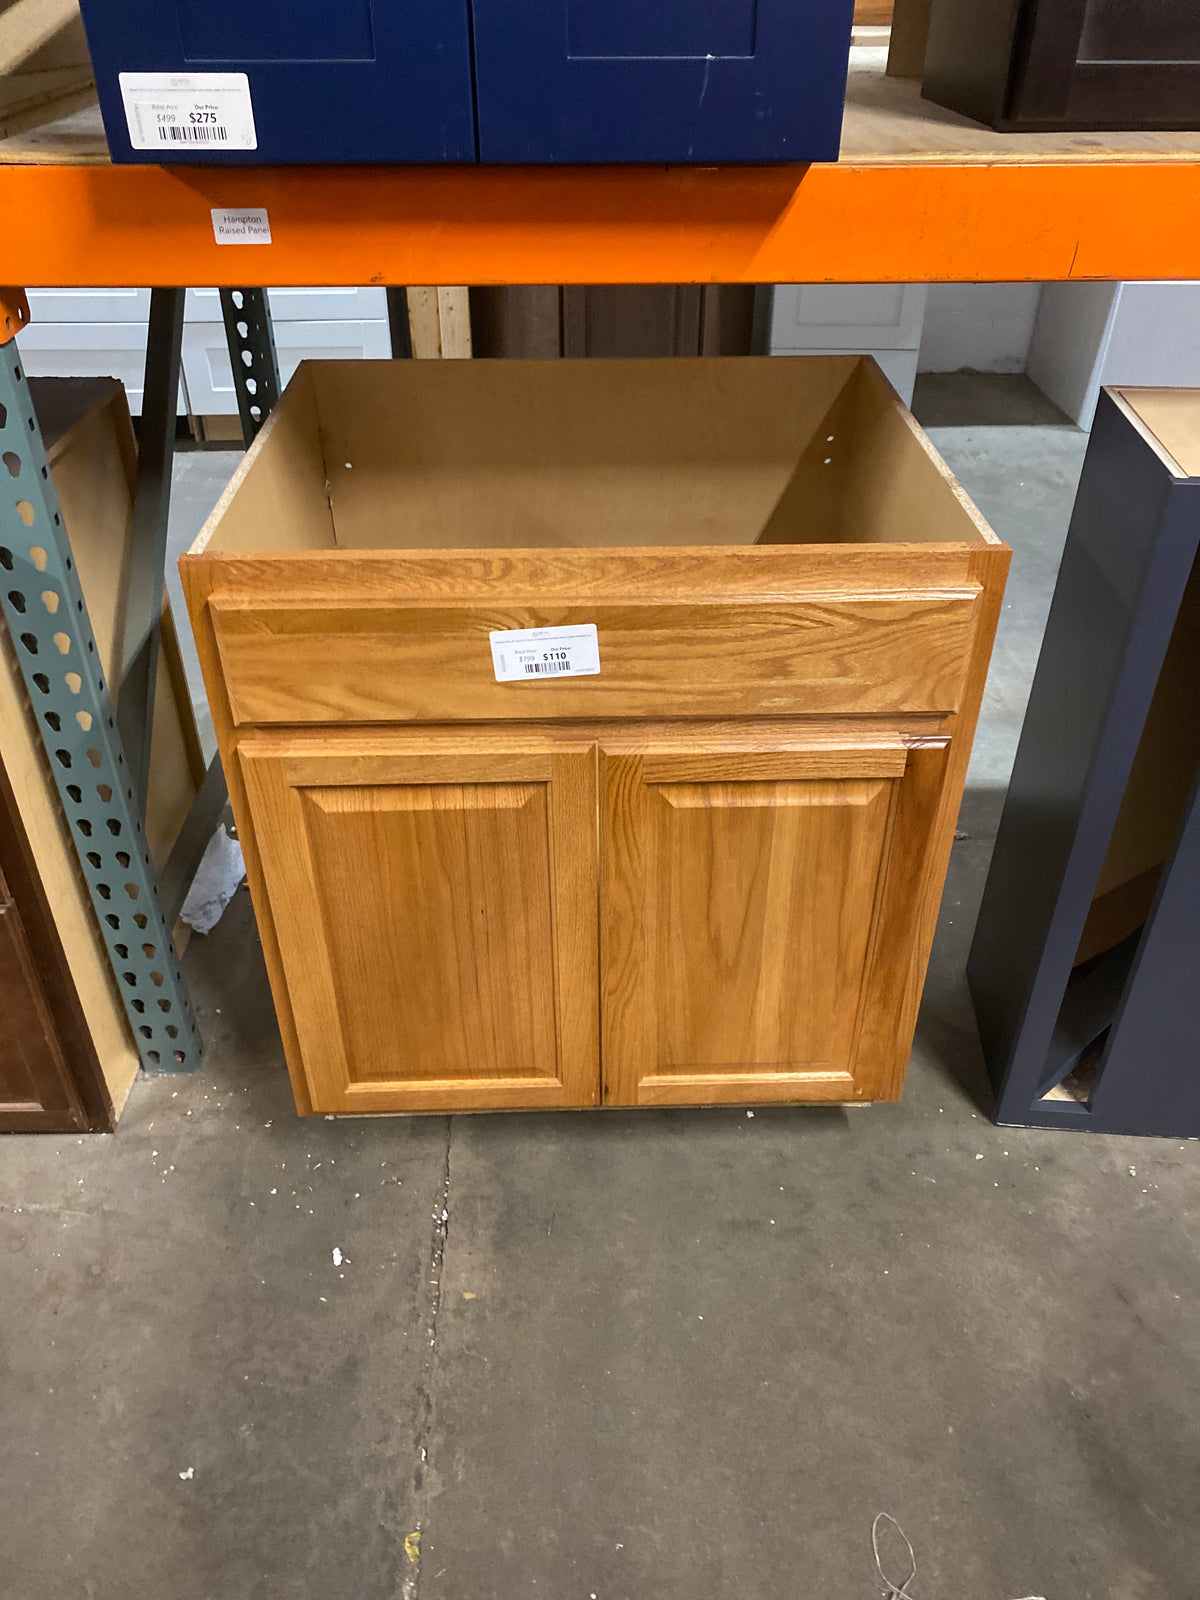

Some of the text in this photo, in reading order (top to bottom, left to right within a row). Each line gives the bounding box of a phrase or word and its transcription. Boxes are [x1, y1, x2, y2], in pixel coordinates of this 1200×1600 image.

[157, 114, 176, 123] $499
[189, 112, 217, 124] $275
[223, 215, 262, 225] Hampton
[219, 226, 270, 234] Raised Panel
[543, 652, 567, 661] $110
